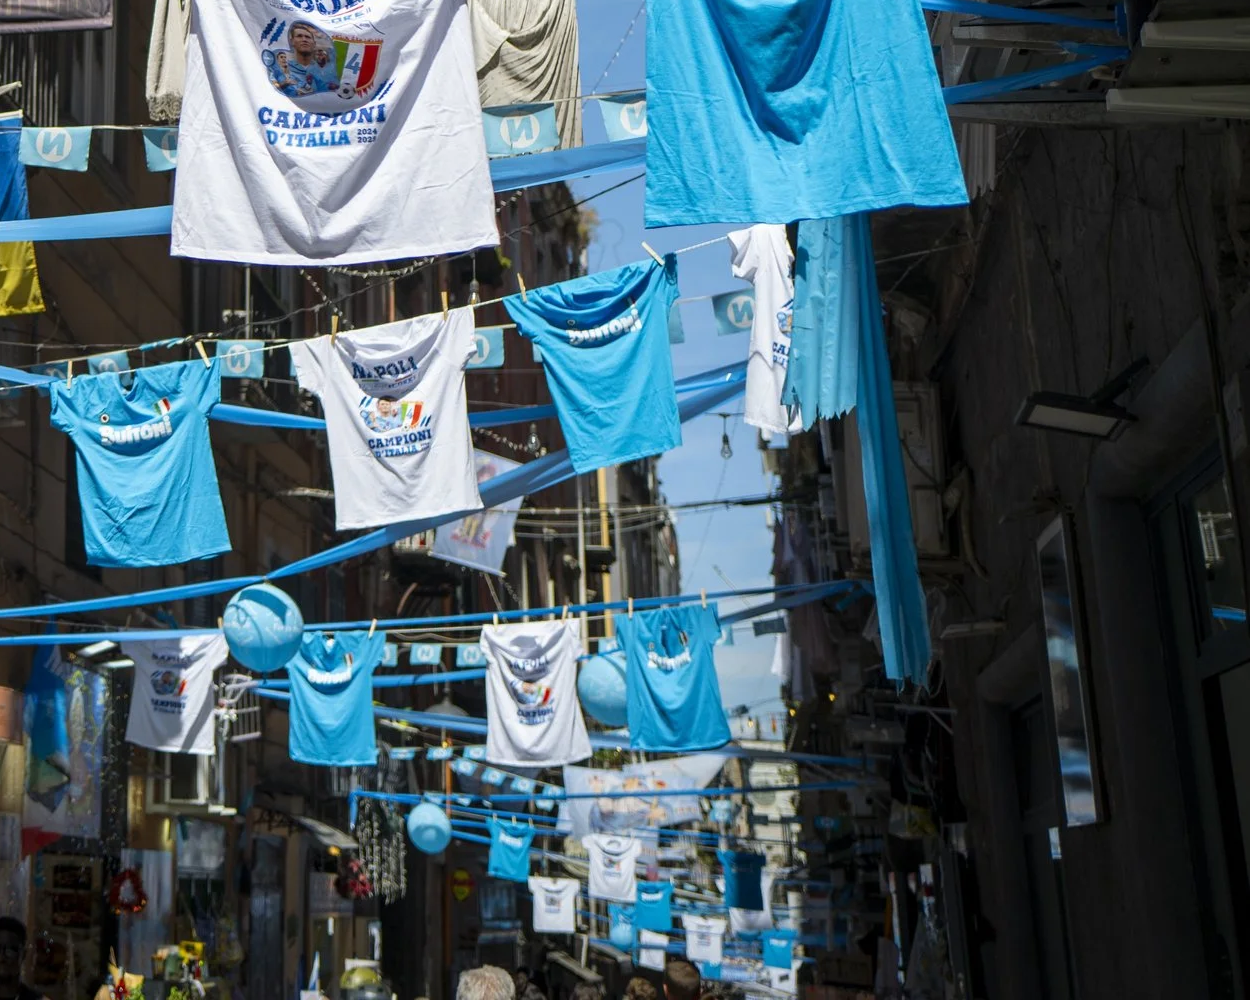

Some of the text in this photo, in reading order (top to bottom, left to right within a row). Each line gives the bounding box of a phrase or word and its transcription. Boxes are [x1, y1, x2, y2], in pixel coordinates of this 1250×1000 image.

[345, 52, 363, 77] 4
[258, 104, 387, 130] CAMPIONI
[266, 130, 351, 148] D'ITALIA
